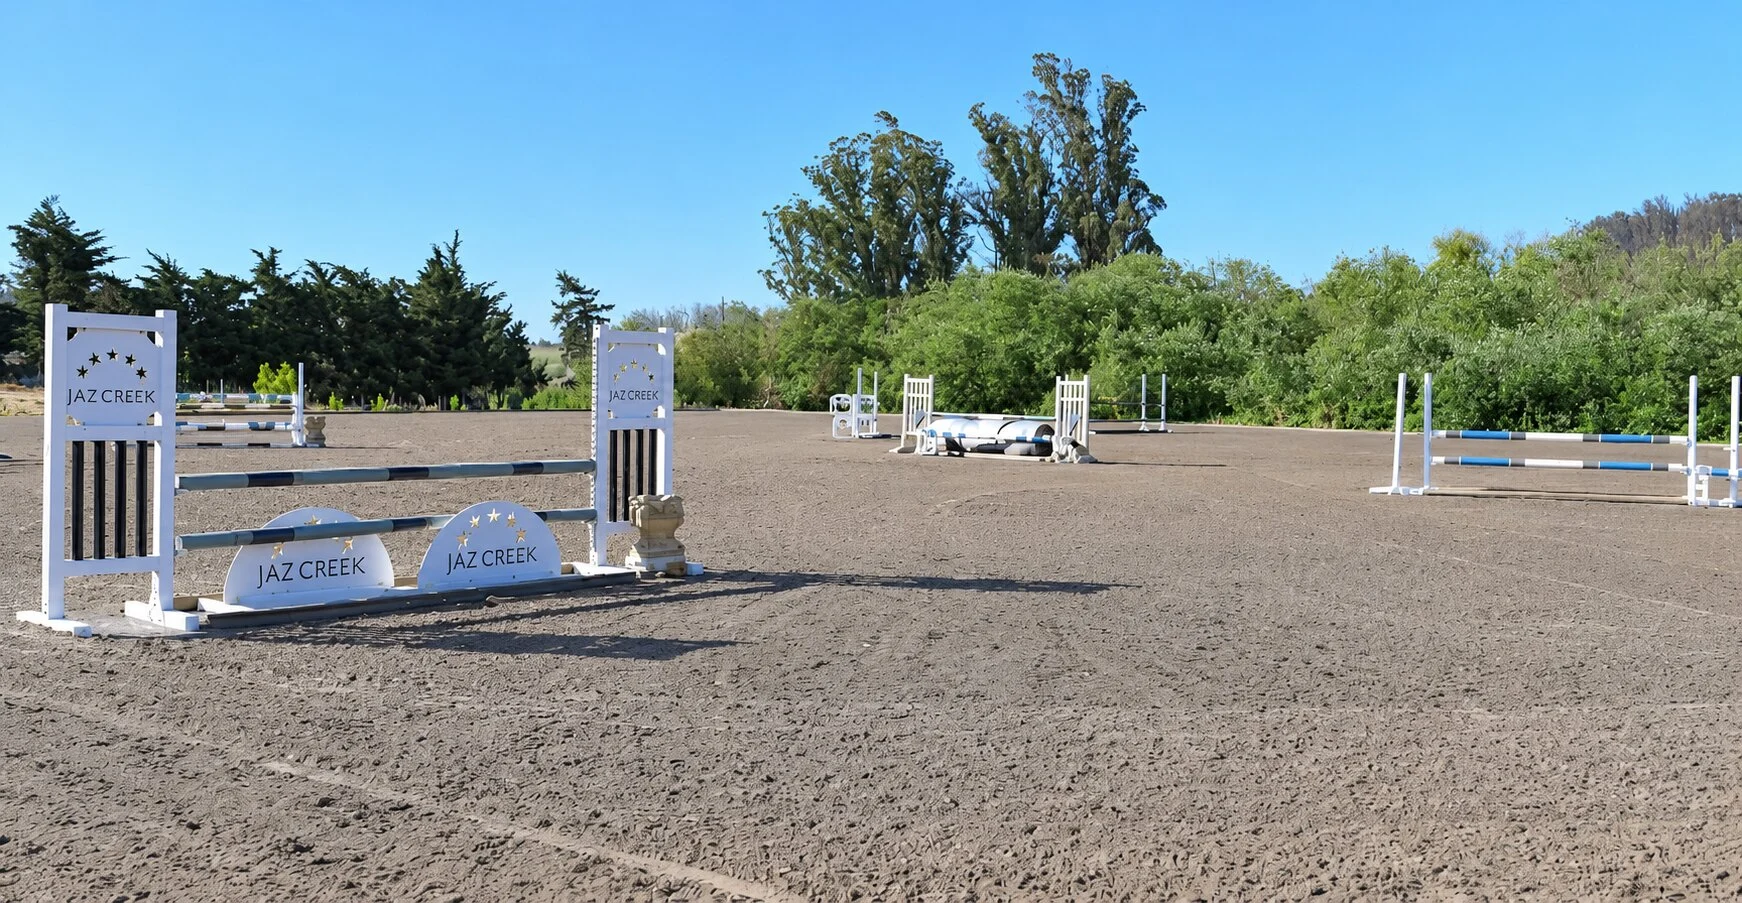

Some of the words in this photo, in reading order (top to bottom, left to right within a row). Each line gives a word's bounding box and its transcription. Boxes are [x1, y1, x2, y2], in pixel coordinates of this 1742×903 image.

[66, 389, 97, 406] JAZ
[101, 389, 155, 403] CREEK
[609, 390, 626, 403] JAZ
[627, 390, 659, 400] CREEK
[446, 551, 477, 575] JAZ
[481, 546, 537, 567] CREEK
[257, 562, 294, 589] JAZ
[299, 556, 366, 579] CREEK
